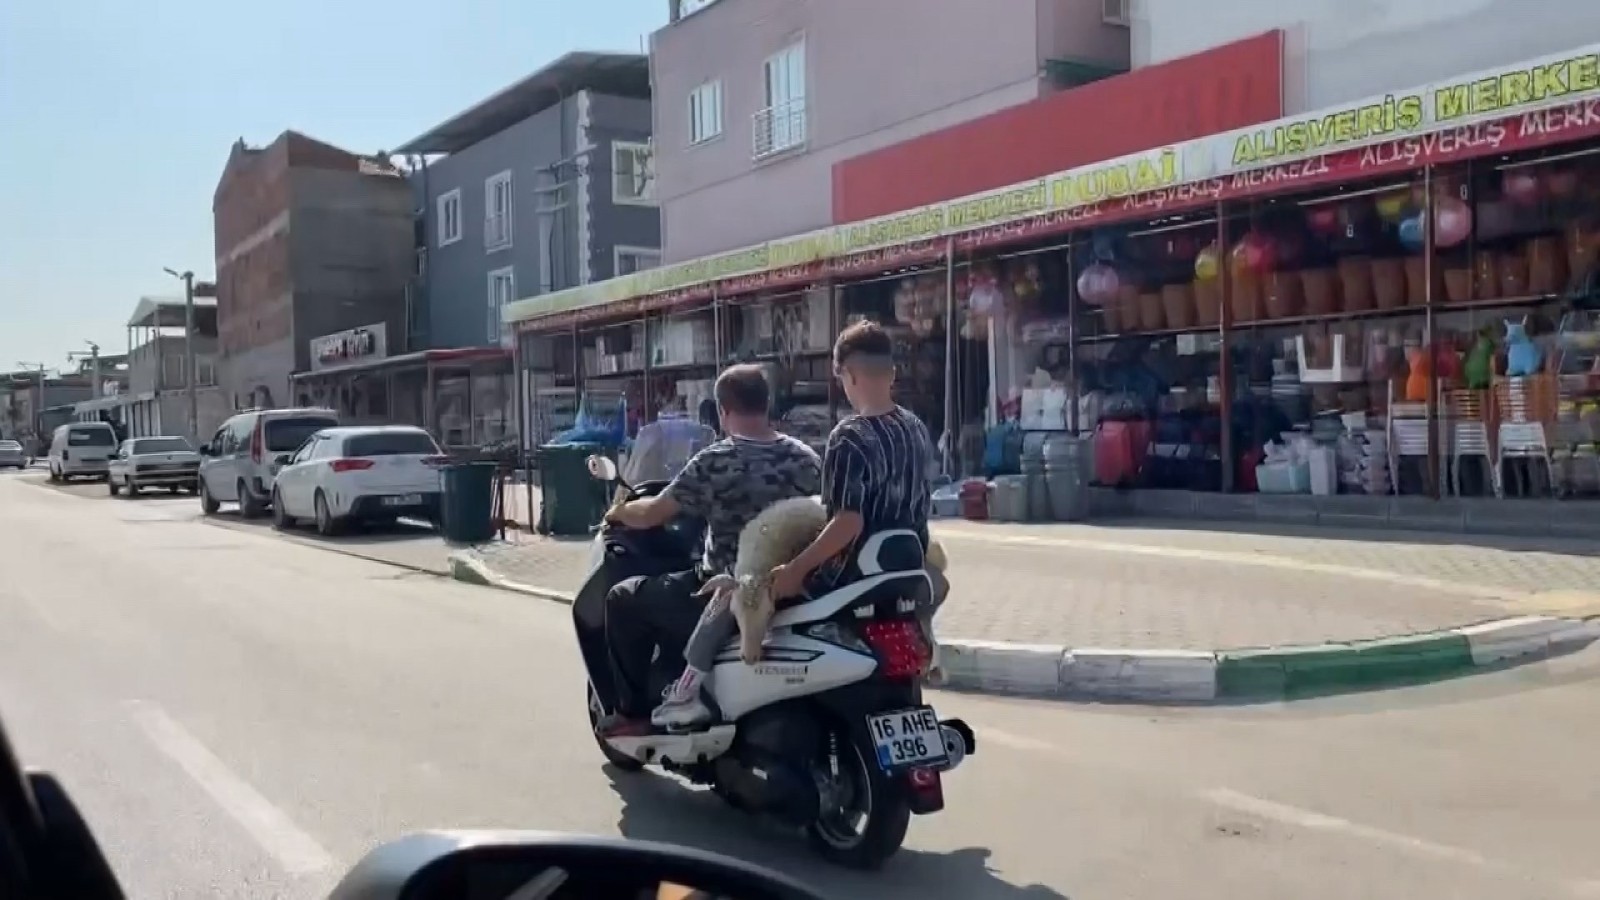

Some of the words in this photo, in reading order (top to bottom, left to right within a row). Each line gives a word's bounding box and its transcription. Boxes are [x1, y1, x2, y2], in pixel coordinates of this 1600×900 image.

[1435, 54, 1600, 121] MERKE
[874, 718, 896, 740] 16
[902, 711, 936, 735] AHE
[892, 737, 928, 760] 396
